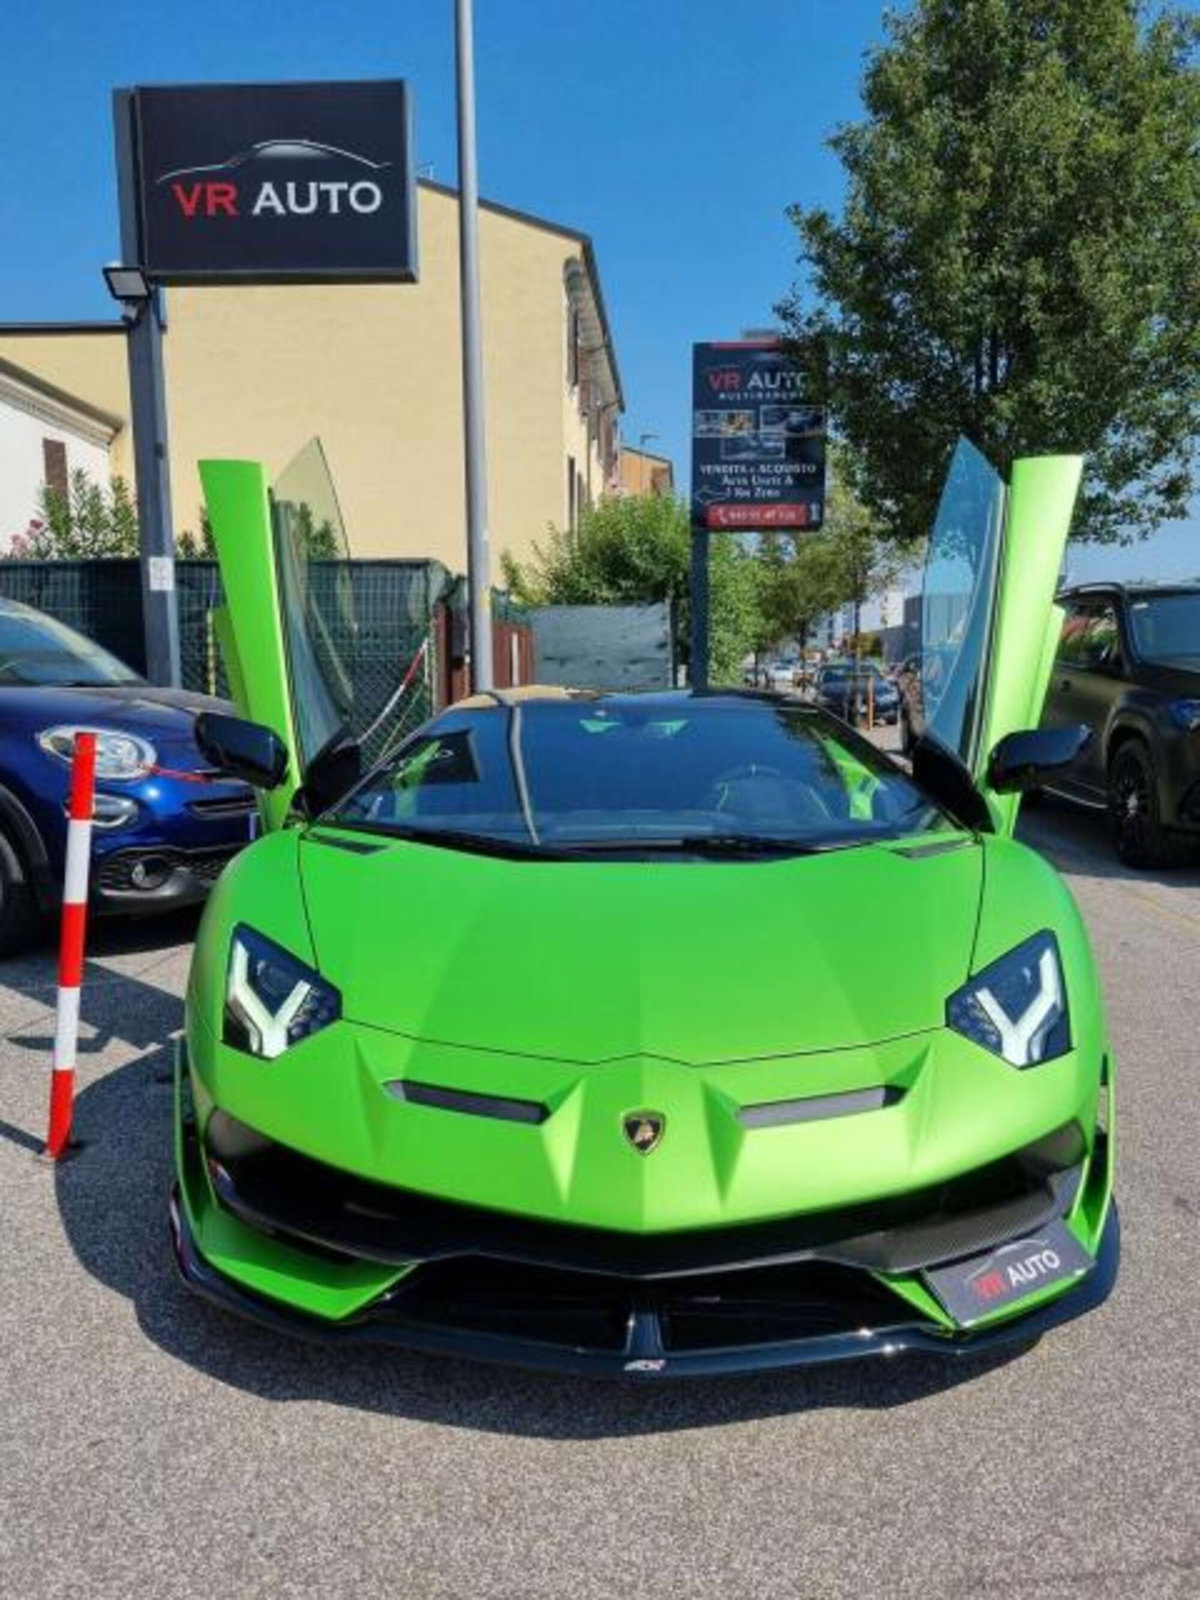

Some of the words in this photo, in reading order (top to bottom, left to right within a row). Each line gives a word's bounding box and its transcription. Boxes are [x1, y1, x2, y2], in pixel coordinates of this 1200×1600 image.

[171, 182, 239, 216] VR
[252, 181, 382, 215] AUTO
[708, 373, 741, 391] VR
[1006, 1249, 1060, 1288] AUTO
